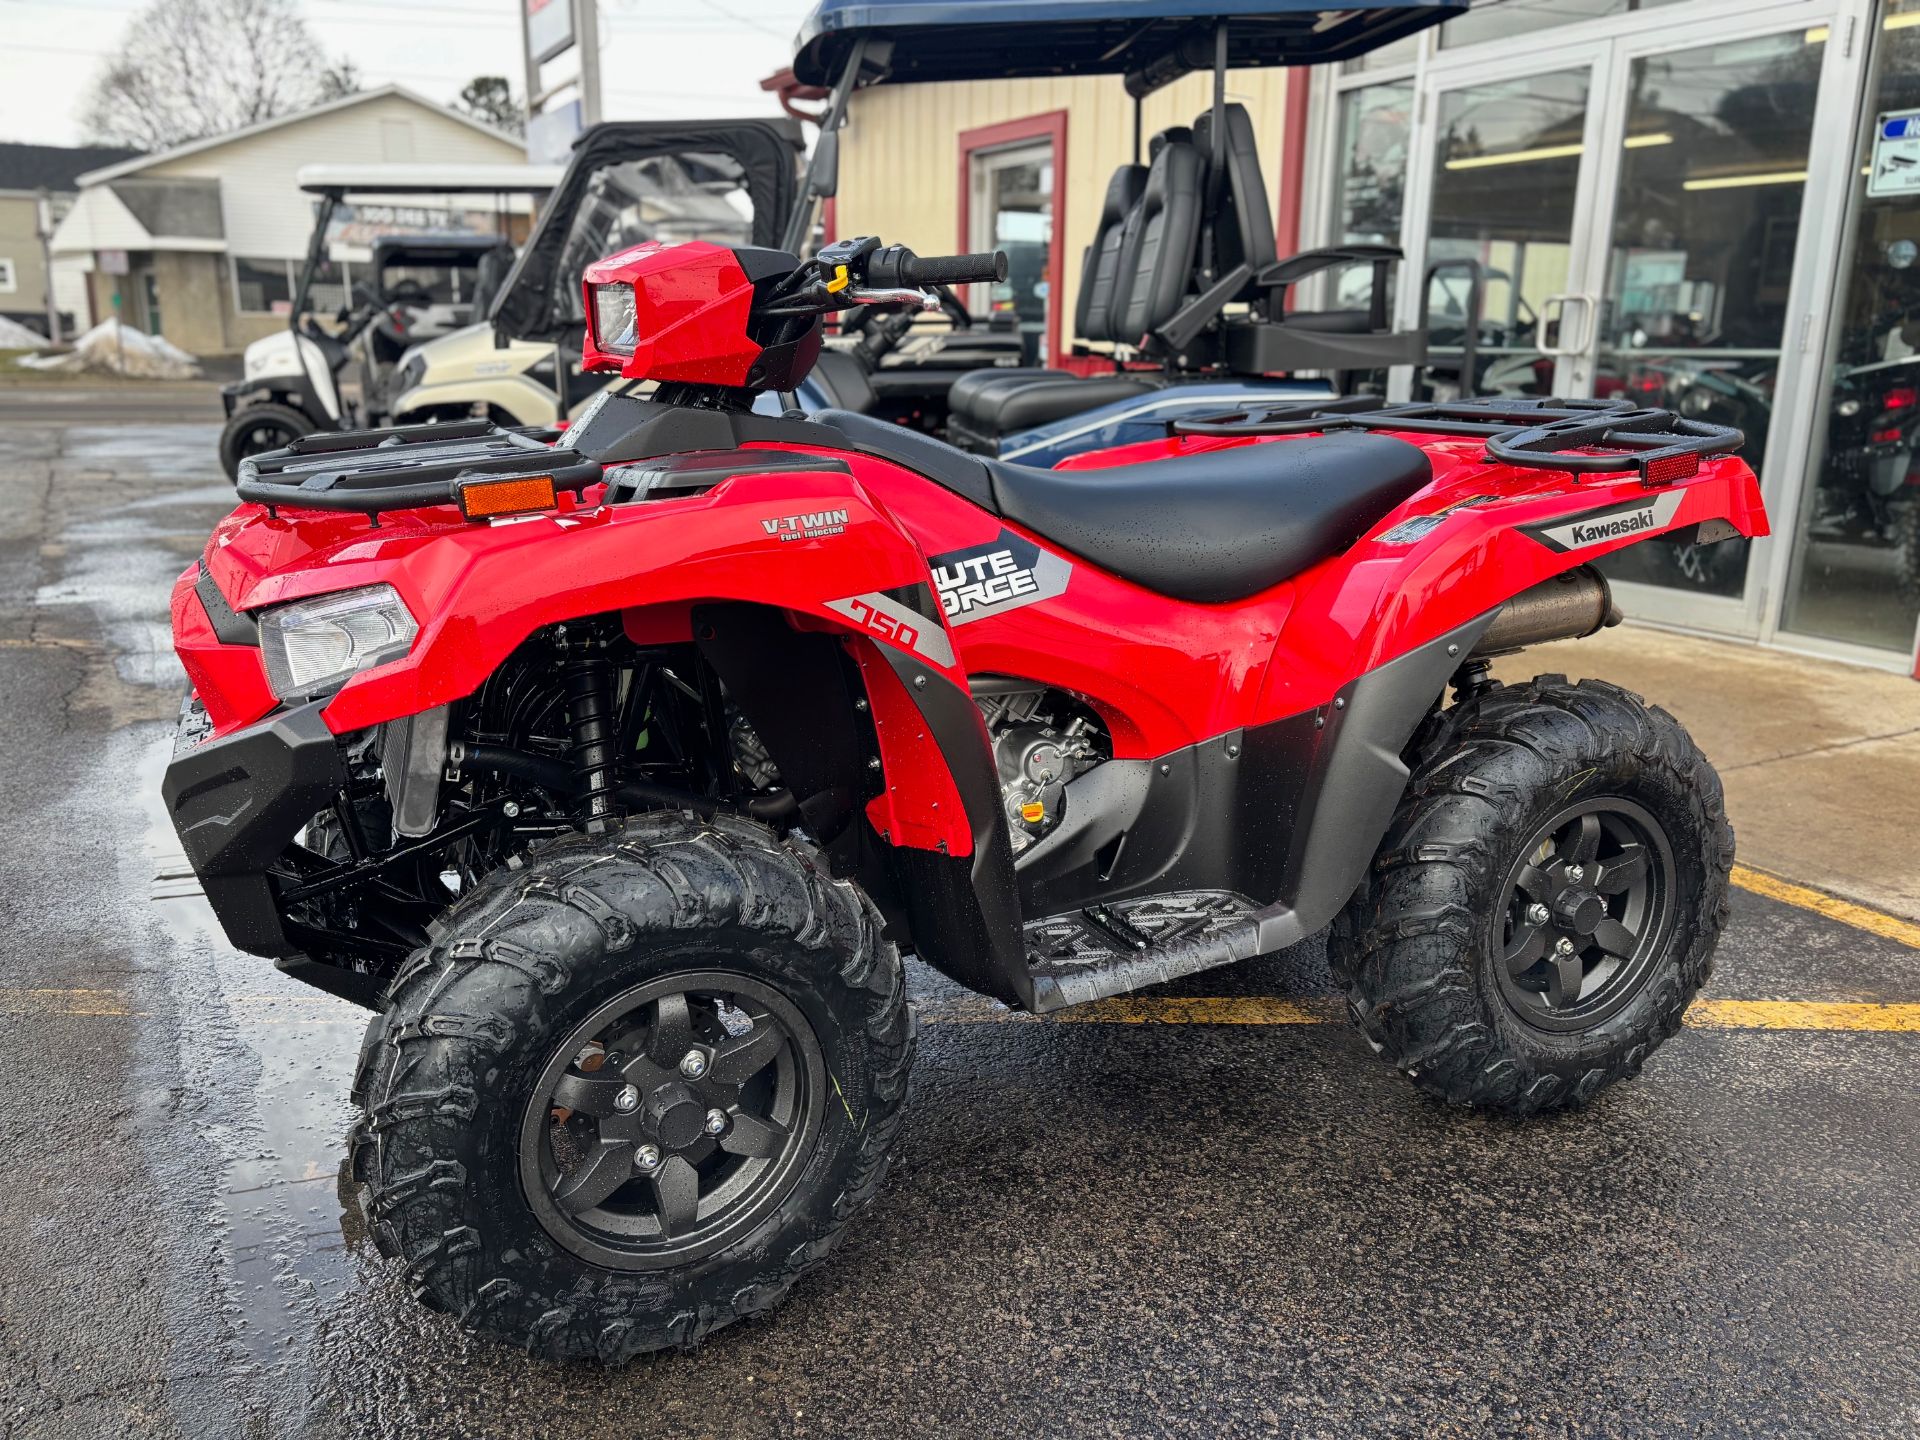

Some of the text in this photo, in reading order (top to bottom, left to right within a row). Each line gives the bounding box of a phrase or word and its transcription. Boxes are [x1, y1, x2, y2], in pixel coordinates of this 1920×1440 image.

[761, 509, 849, 534] V-TWIN
[780, 526, 845, 542] Fuel Injected
[1571, 509, 1654, 544] Kawasaki
[931, 549, 1018, 592] UTE
[940, 568, 1037, 616] ORCE
[850, 599, 919, 650] 750
